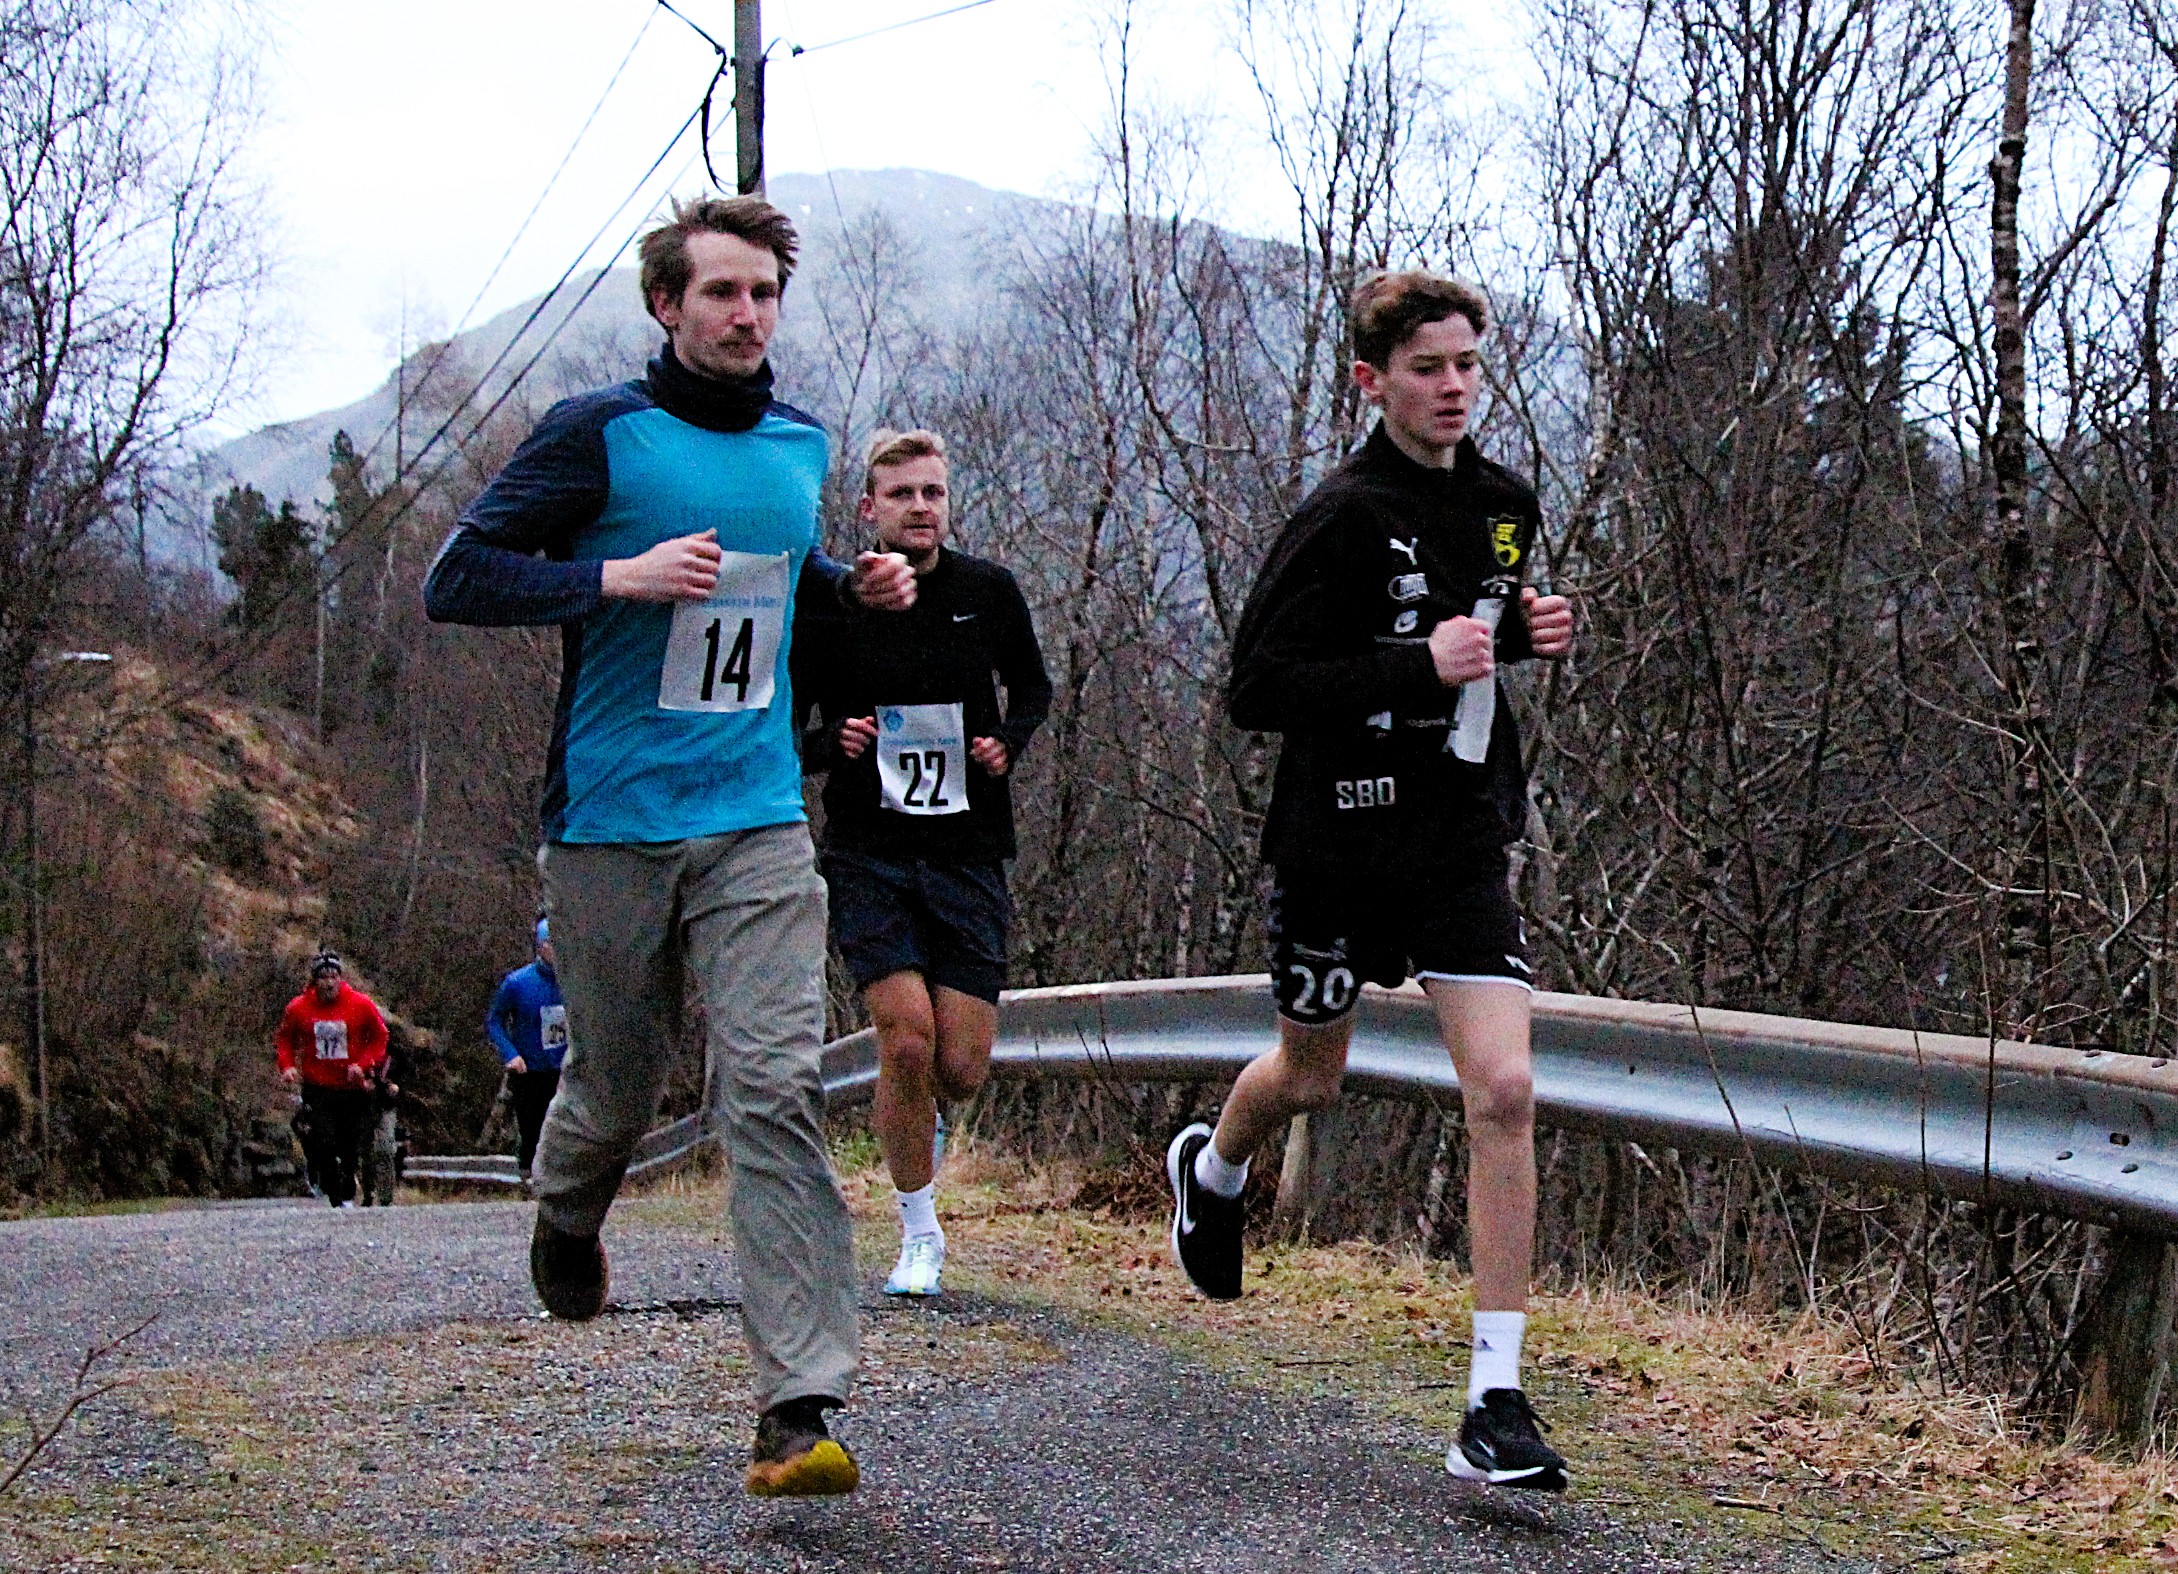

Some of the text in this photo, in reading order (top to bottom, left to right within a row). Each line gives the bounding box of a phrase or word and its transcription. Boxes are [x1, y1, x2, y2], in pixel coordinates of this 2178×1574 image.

[700, 618, 753, 702] 14
[899, 752, 948, 806] 22
[1289, 965, 1355, 1014] 20
